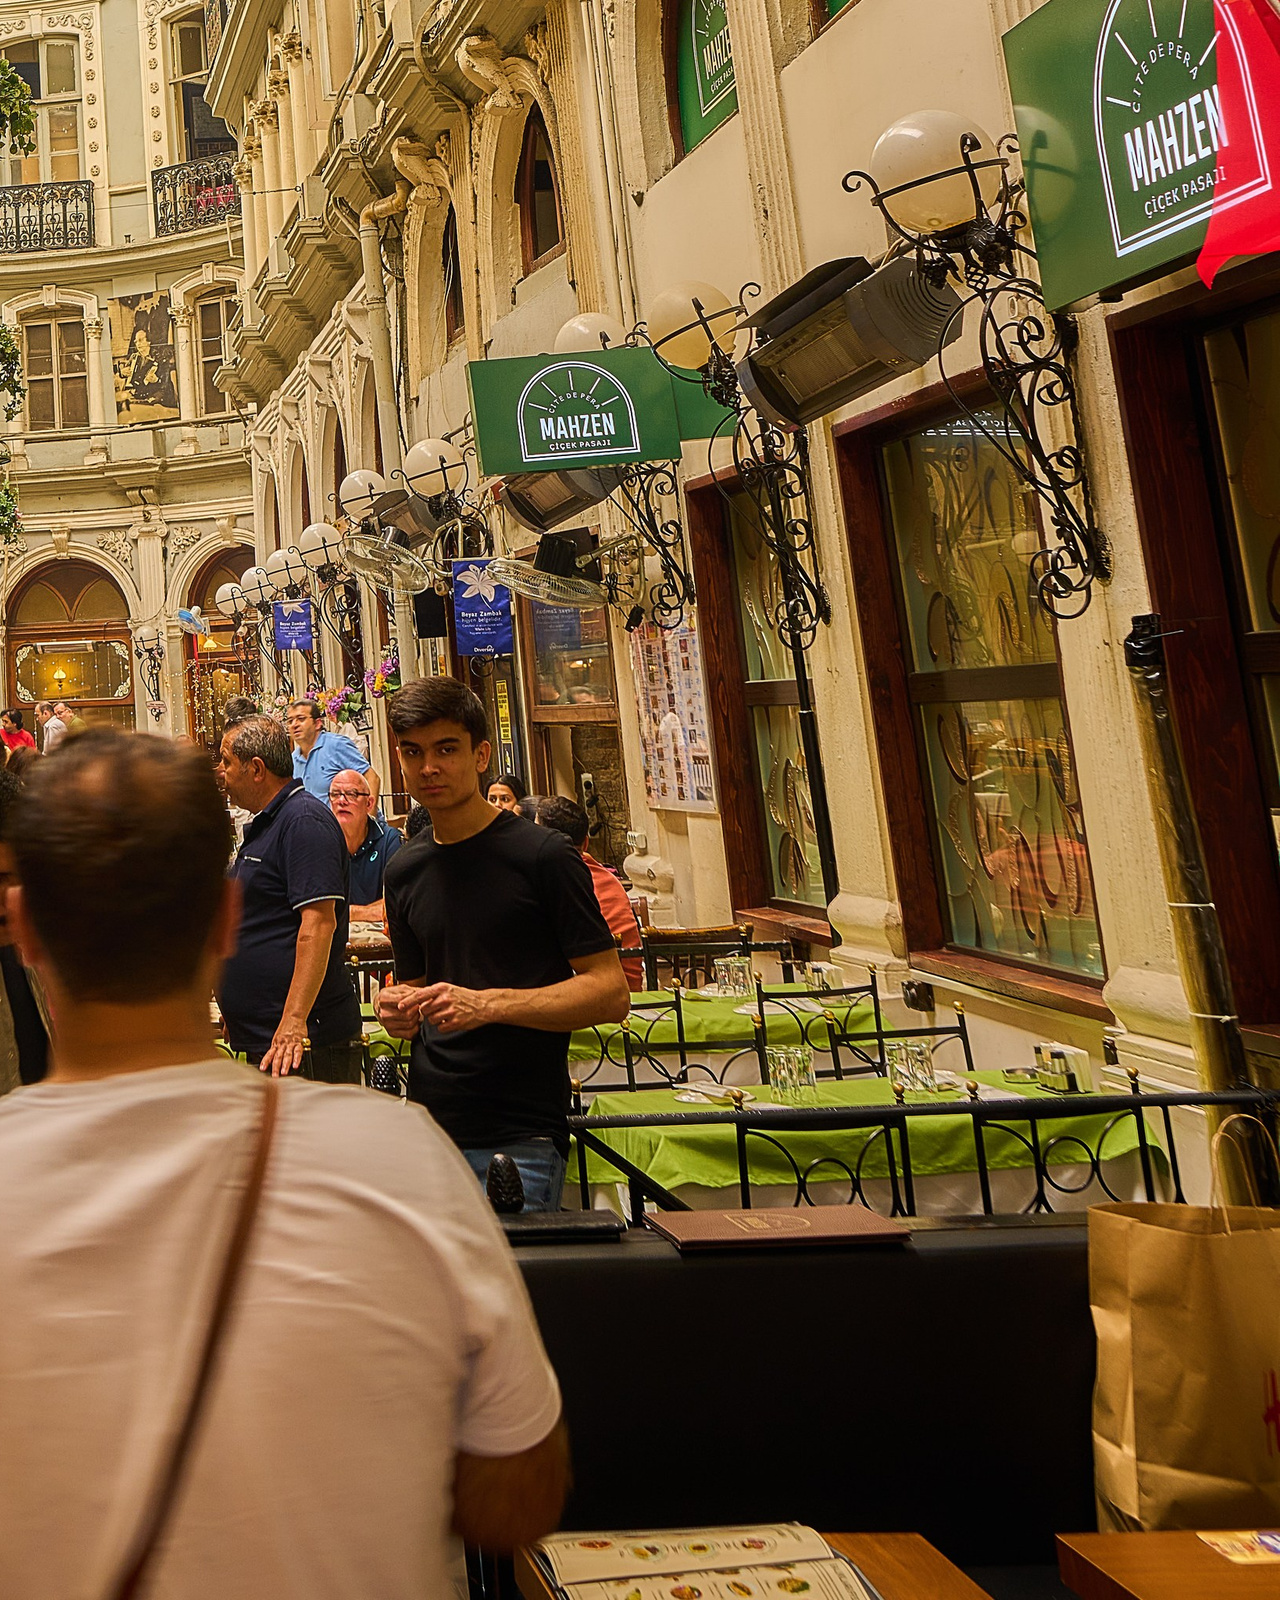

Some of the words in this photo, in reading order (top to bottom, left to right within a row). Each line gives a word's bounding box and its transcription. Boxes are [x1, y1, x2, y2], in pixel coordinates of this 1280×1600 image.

[703, 24, 733, 80] MAHZE
[1132, 60, 1150, 114] CITE
[1148, 42, 1166, 64] DE
[1168, 41, 1199, 80] PERA
[1124, 84, 1230, 192] MAHZEN
[1144, 187, 1182, 219] ÇİÇEK
[1181, 166, 1227, 199] PASAJI
[548, 394, 565, 414] CITE
[566, 391, 578, 399] DE
[580, 392, 601, 410] PERA
[539, 412, 616, 441] MAHZEN
[549, 442, 578, 451] ÇİÇEK
[579, 439, 611, 448] PASAJI
[479, 609, 502, 617] Zambak
